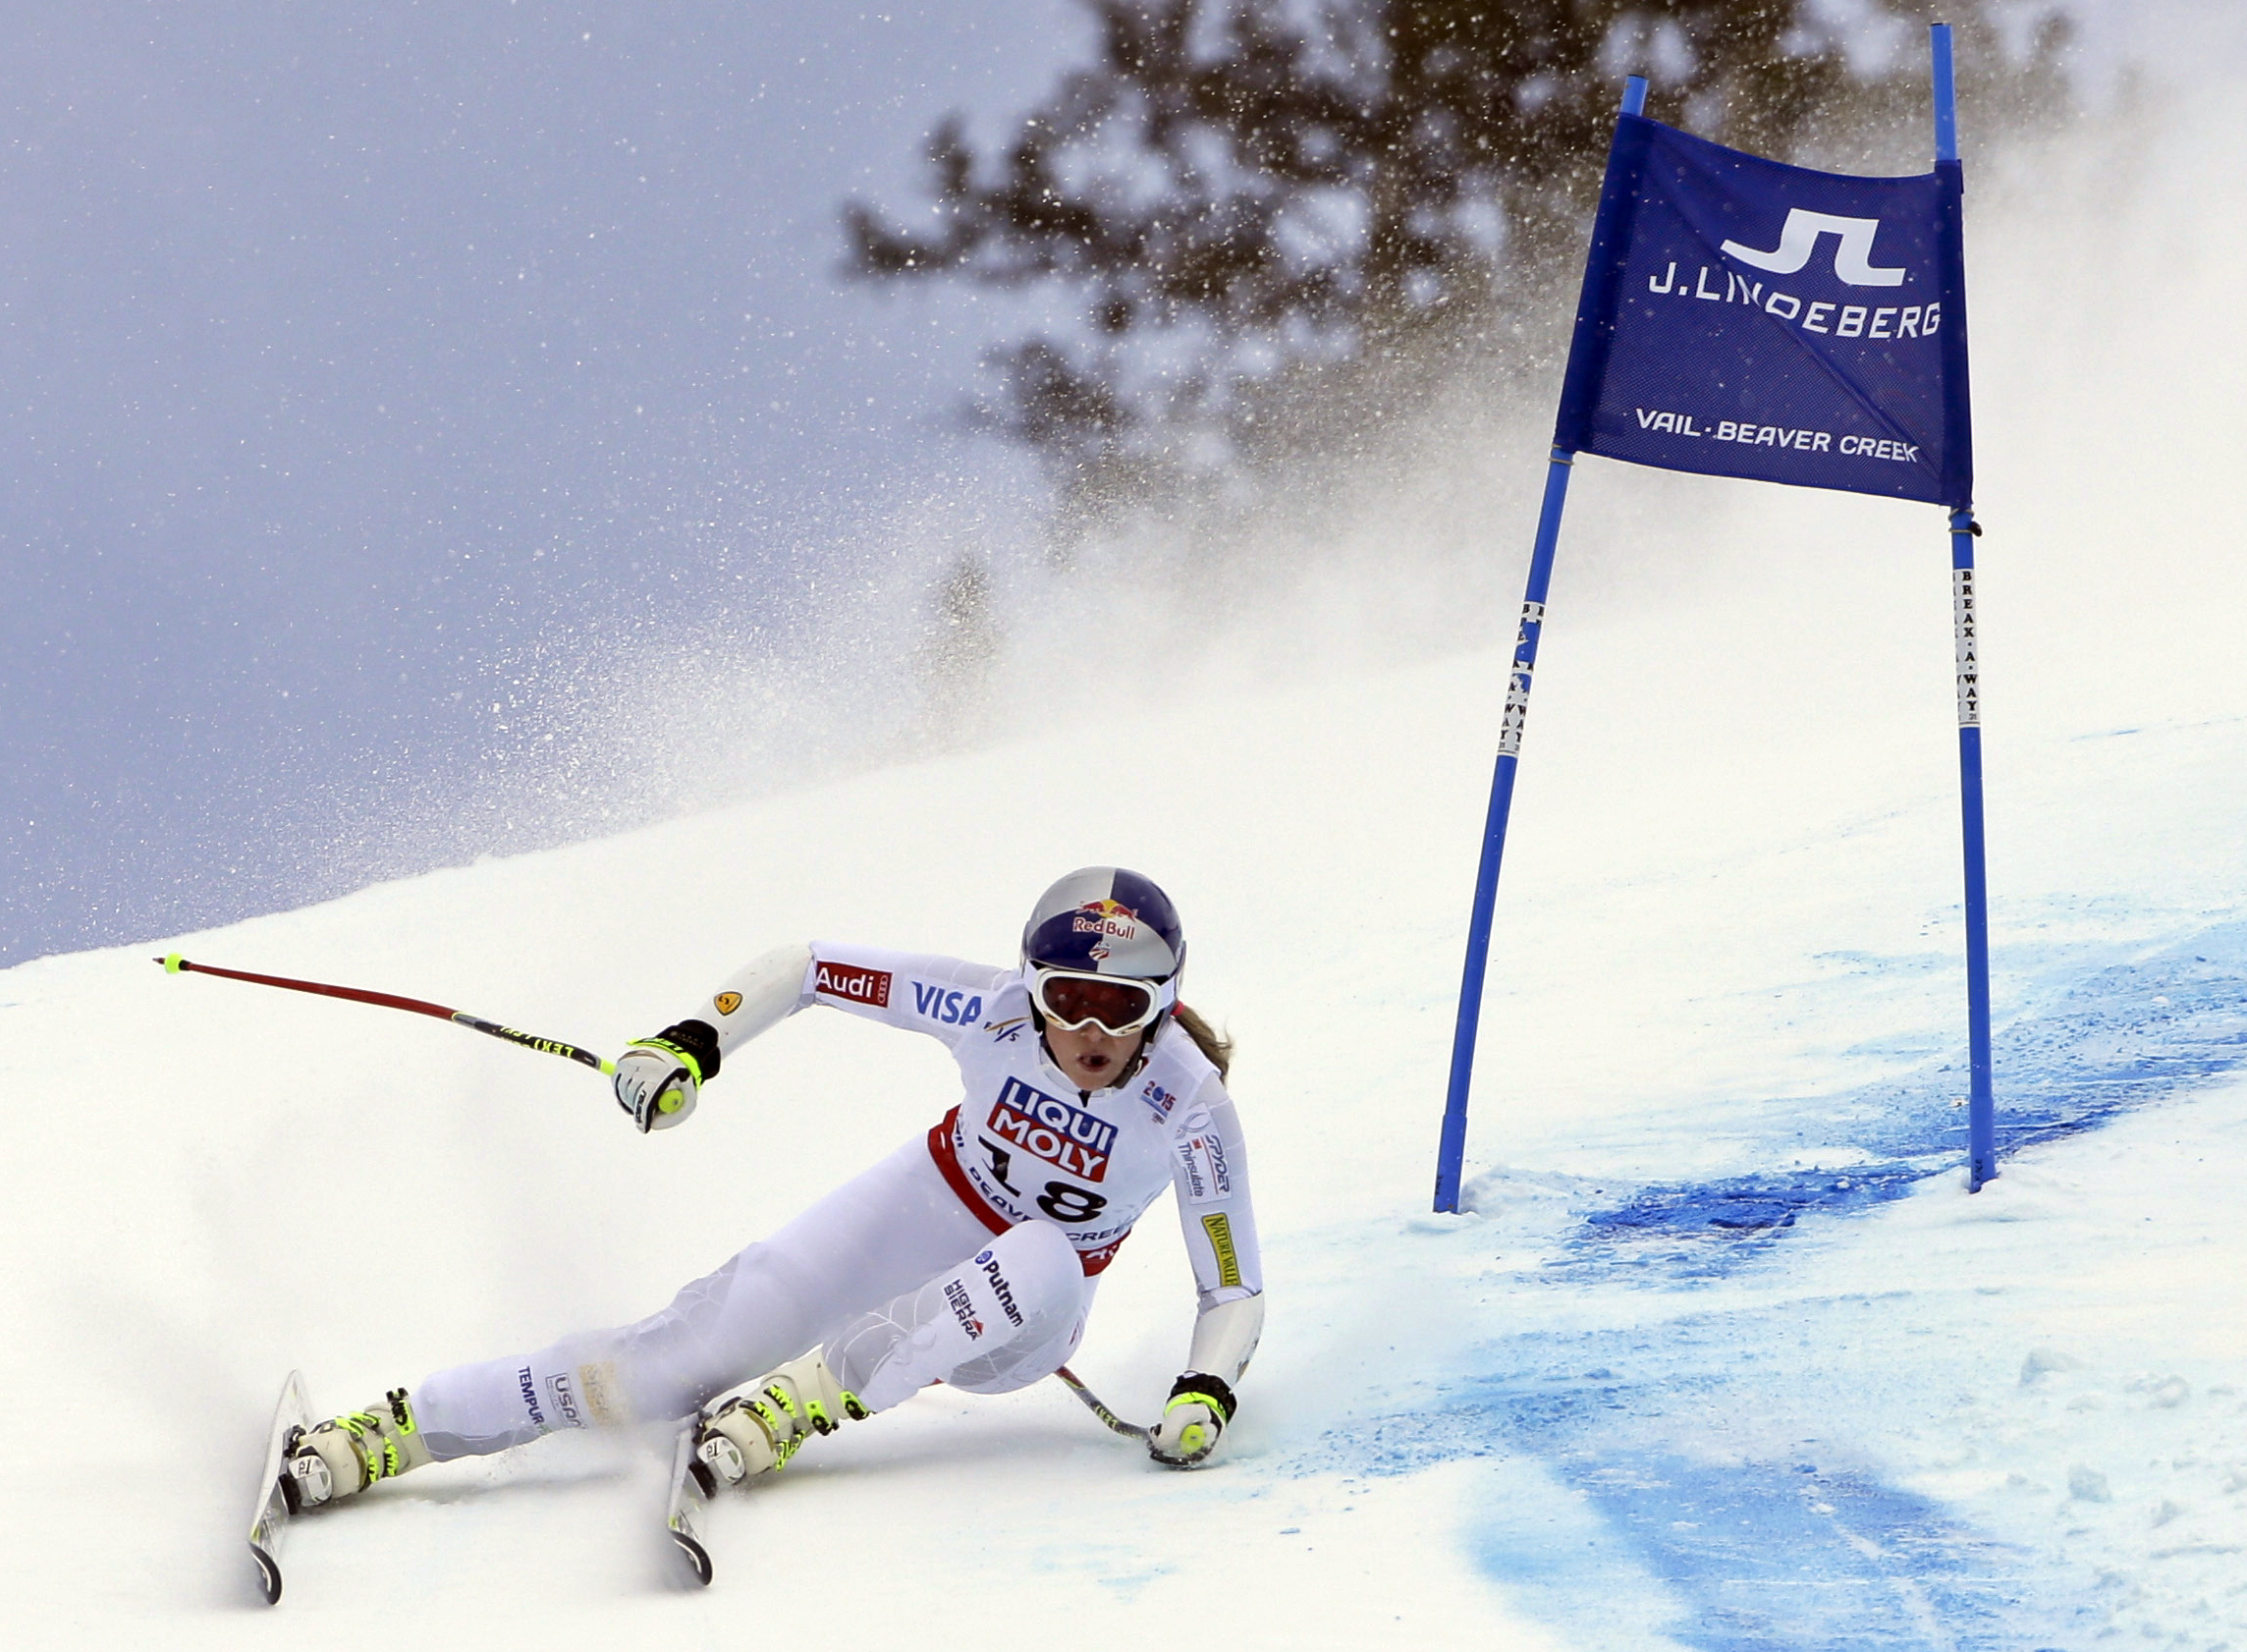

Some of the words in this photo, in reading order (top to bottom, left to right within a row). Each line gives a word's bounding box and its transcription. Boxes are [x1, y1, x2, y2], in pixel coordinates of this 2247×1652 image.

[1649, 261, 1941, 339] J.LINDEBERG
[1838, 435, 1920, 463] CREEK
[1072, 917, 1105, 934] Red
[1106, 920, 1135, 941] Bull
[816, 966, 874, 999] Audi
[911, 980, 982, 1026] VISA
[993, 1109, 1105, 1178] MOLY
[1005, 1080, 1114, 1149] LIQUI
[1204, 1133, 1230, 1193] SPYDER
[952, 1278, 976, 1318] HIGH
[982, 1259, 1024, 1328] Putnam
[518, 1365, 545, 1425] TEMPUR
